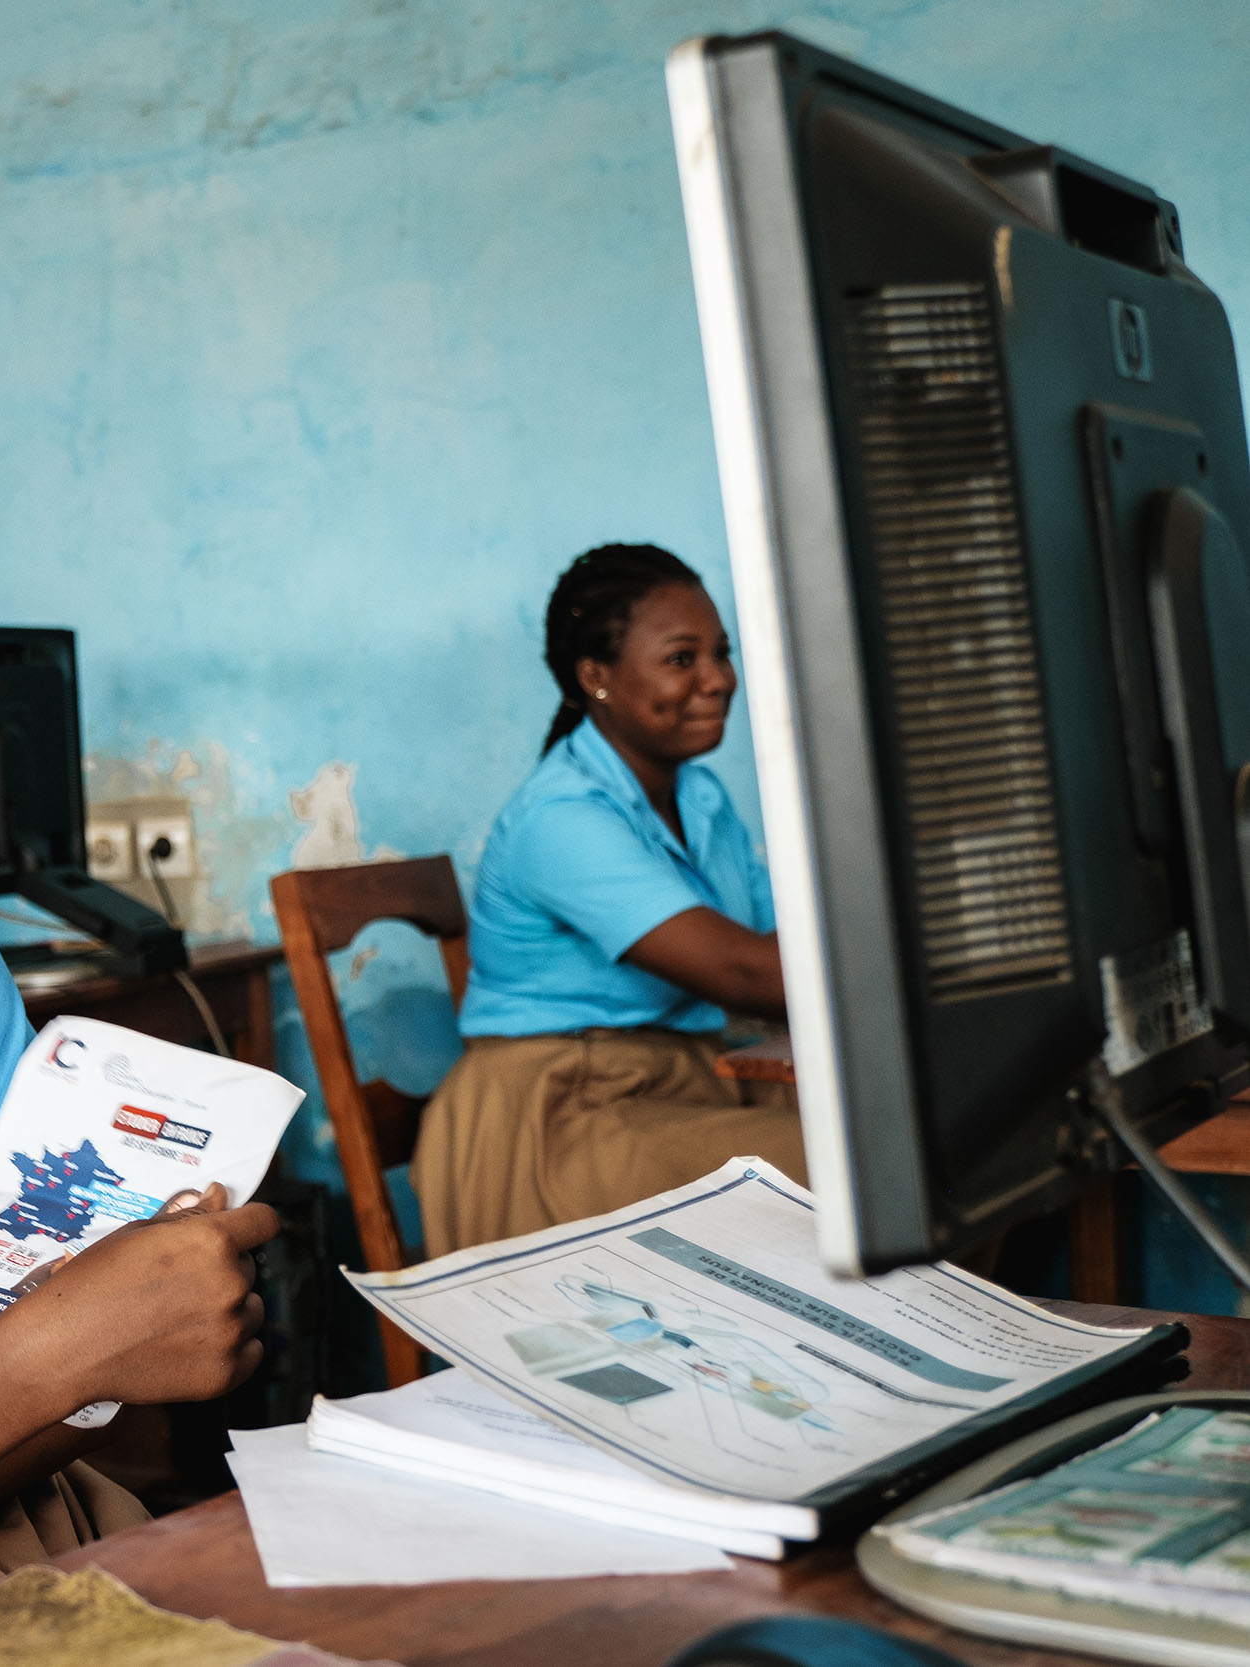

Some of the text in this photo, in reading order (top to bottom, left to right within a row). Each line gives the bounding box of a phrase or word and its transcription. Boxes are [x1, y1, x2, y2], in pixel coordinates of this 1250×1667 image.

[705, 1268, 726, 1280] DE
[698, 1256, 922, 1361] DACTYLO SUR ORDINATEUR
